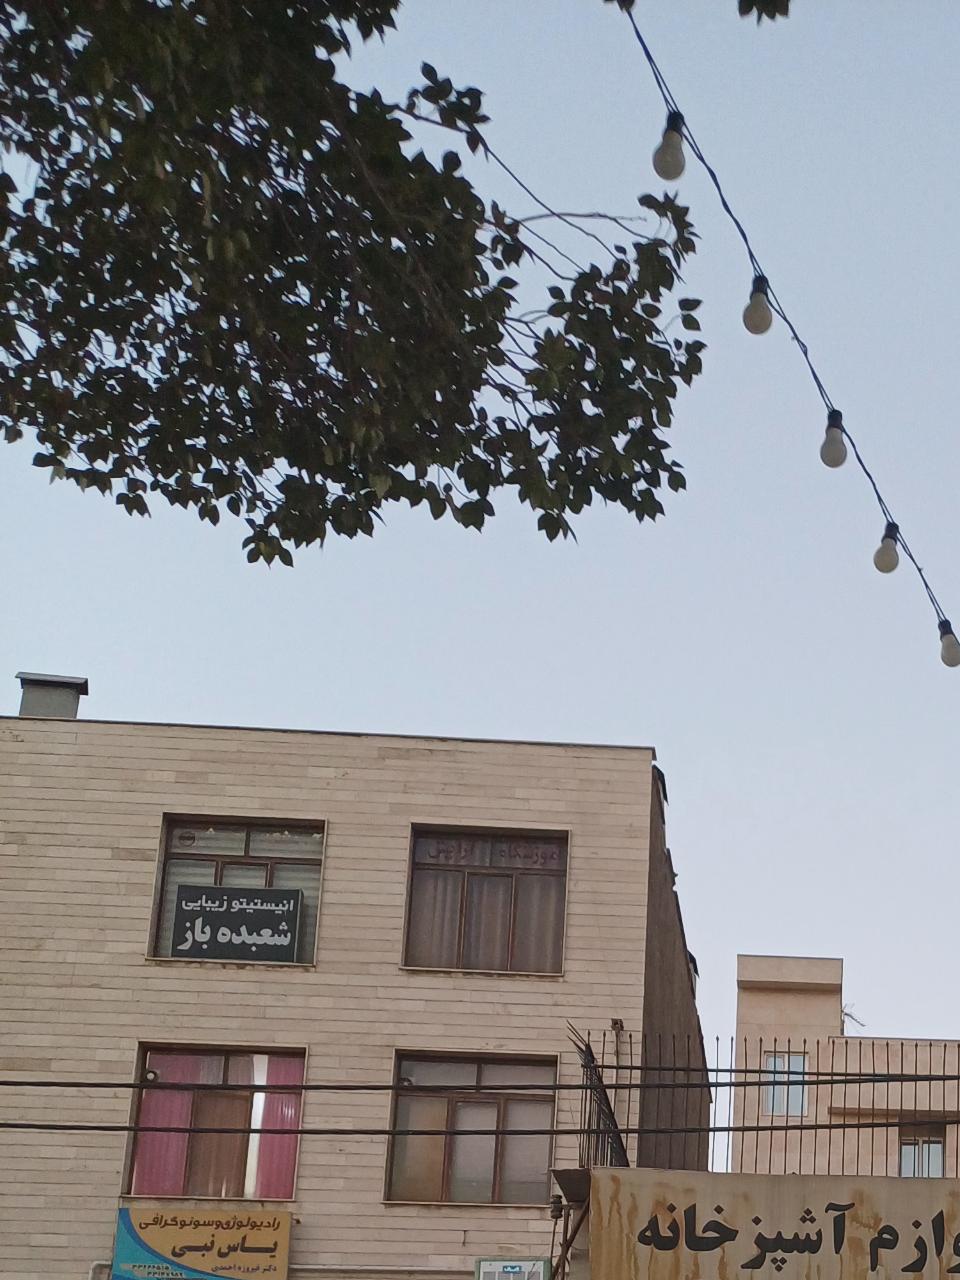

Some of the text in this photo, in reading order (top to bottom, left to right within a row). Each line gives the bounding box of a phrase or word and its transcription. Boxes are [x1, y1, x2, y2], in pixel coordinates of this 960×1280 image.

[181, 894, 294, 914] انیستیتو زیبایی
[177, 916, 291, 951] شعبده باز
[171, 1234, 279, 1258] یاس نبی
[637, 1201, 855, 1272] آشپزخانه
[261, 1264, 278, 1273] دکتر
